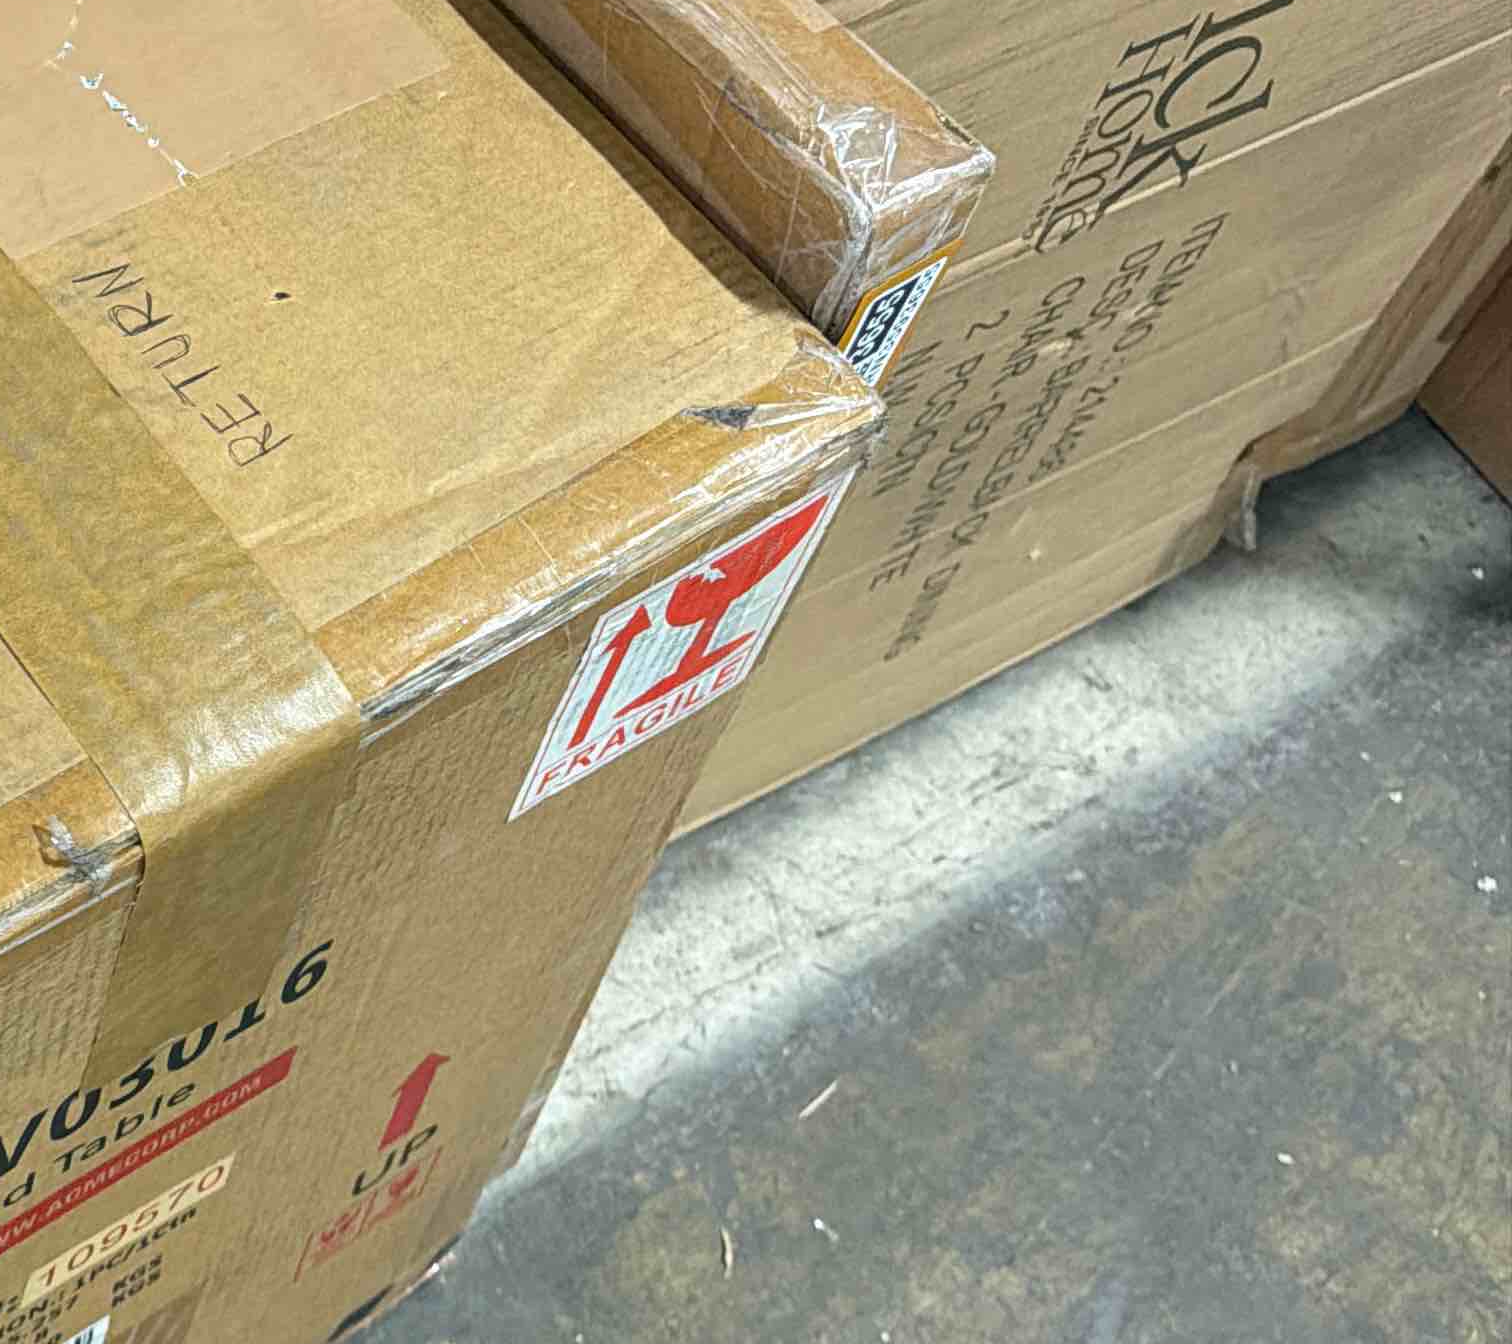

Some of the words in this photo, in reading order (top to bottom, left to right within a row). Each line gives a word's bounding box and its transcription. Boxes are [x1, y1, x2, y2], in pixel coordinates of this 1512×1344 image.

[1036, 23, 1201, 254] Home
[71, 263, 294, 468] RETURN
[536, 655, 746, 796] FRAGILE
[53, 1083, 197, 1174] Table
[352, 1123, 439, 1197] UP
[39, 1164, 225, 1288] 109570
